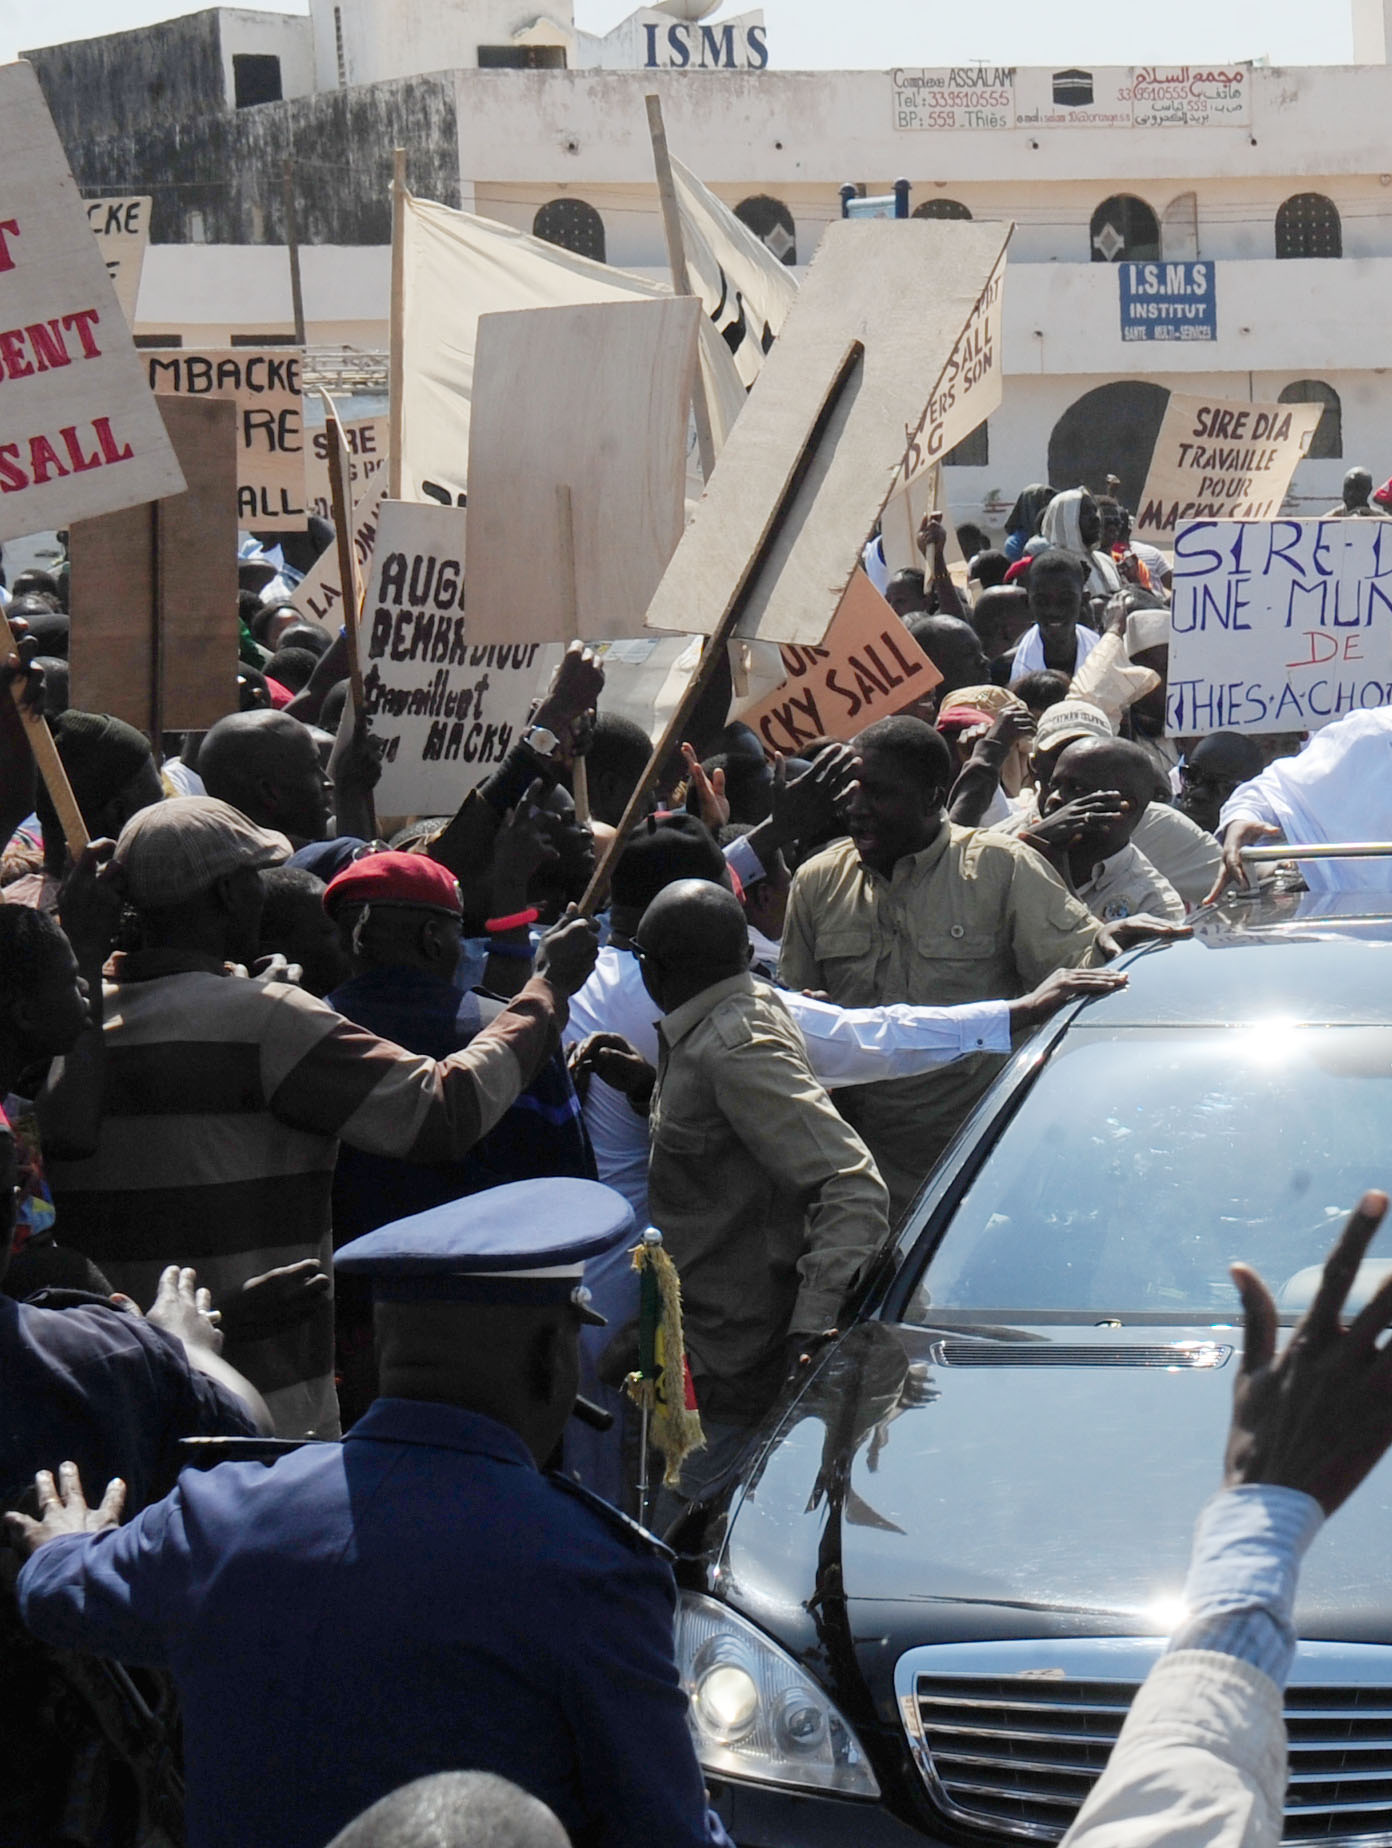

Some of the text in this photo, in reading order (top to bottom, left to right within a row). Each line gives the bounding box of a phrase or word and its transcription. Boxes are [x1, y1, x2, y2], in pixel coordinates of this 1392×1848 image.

[948, 67, 1014, 89] ASSALAM
[928, 91, 1010, 108] 339510555
[928, 111, 956, 128] 559
[1129, 264, 1207, 295] I.S.M.S
[1129, 302, 1207, 319] INSTITUT
[0, 308, 101, 384] ENT
[947, 316, 983, 384] SALL
[149, 357, 302, 395] MBACKE
[964, 345, 983, 394] SON
[1193, 407, 1293, 441] SIRE DIA
[0, 416, 134, 494] SALL
[1177, 443, 1278, 472] TRAVAILLE
[238, 485, 304, 519] ALL
[1197, 476, 1253, 498] POUR
[379, 552, 465, 611] AUG
[1171, 577, 1252, 633] UNE
[1285, 630, 1364, 668] DE
[759, 687, 826, 757] CKY
[826, 631, 923, 718] SALL
[422, 720, 513, 764] MACKY
